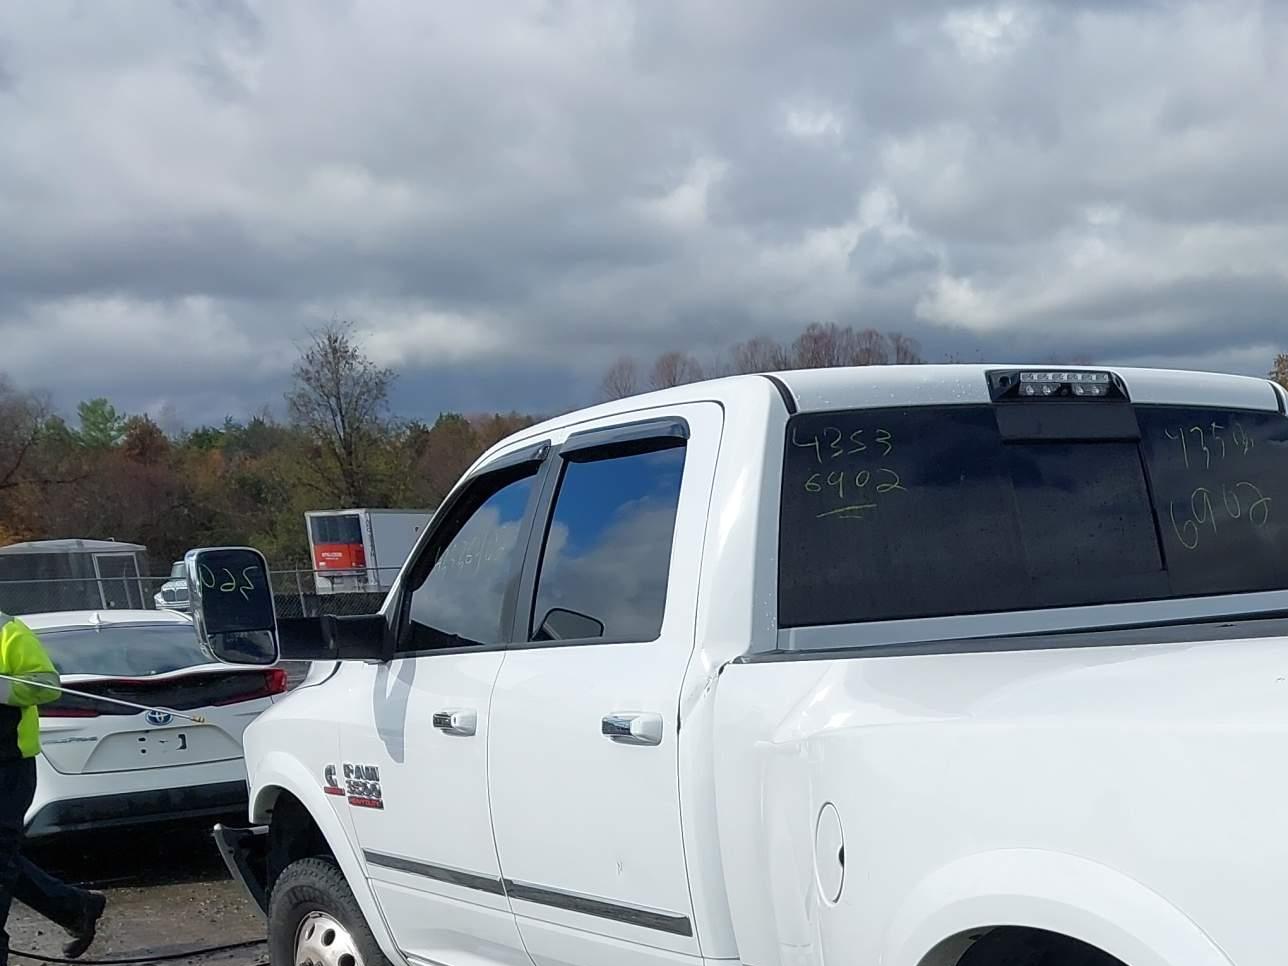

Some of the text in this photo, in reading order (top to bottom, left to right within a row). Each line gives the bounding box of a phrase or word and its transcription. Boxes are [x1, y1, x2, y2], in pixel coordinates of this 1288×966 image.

[791, 426, 893, 464] 4353
[804, 467, 910, 498] 6902
[1169, 481, 1272, 550] 6902
[342, 763, 380, 782] RAM
